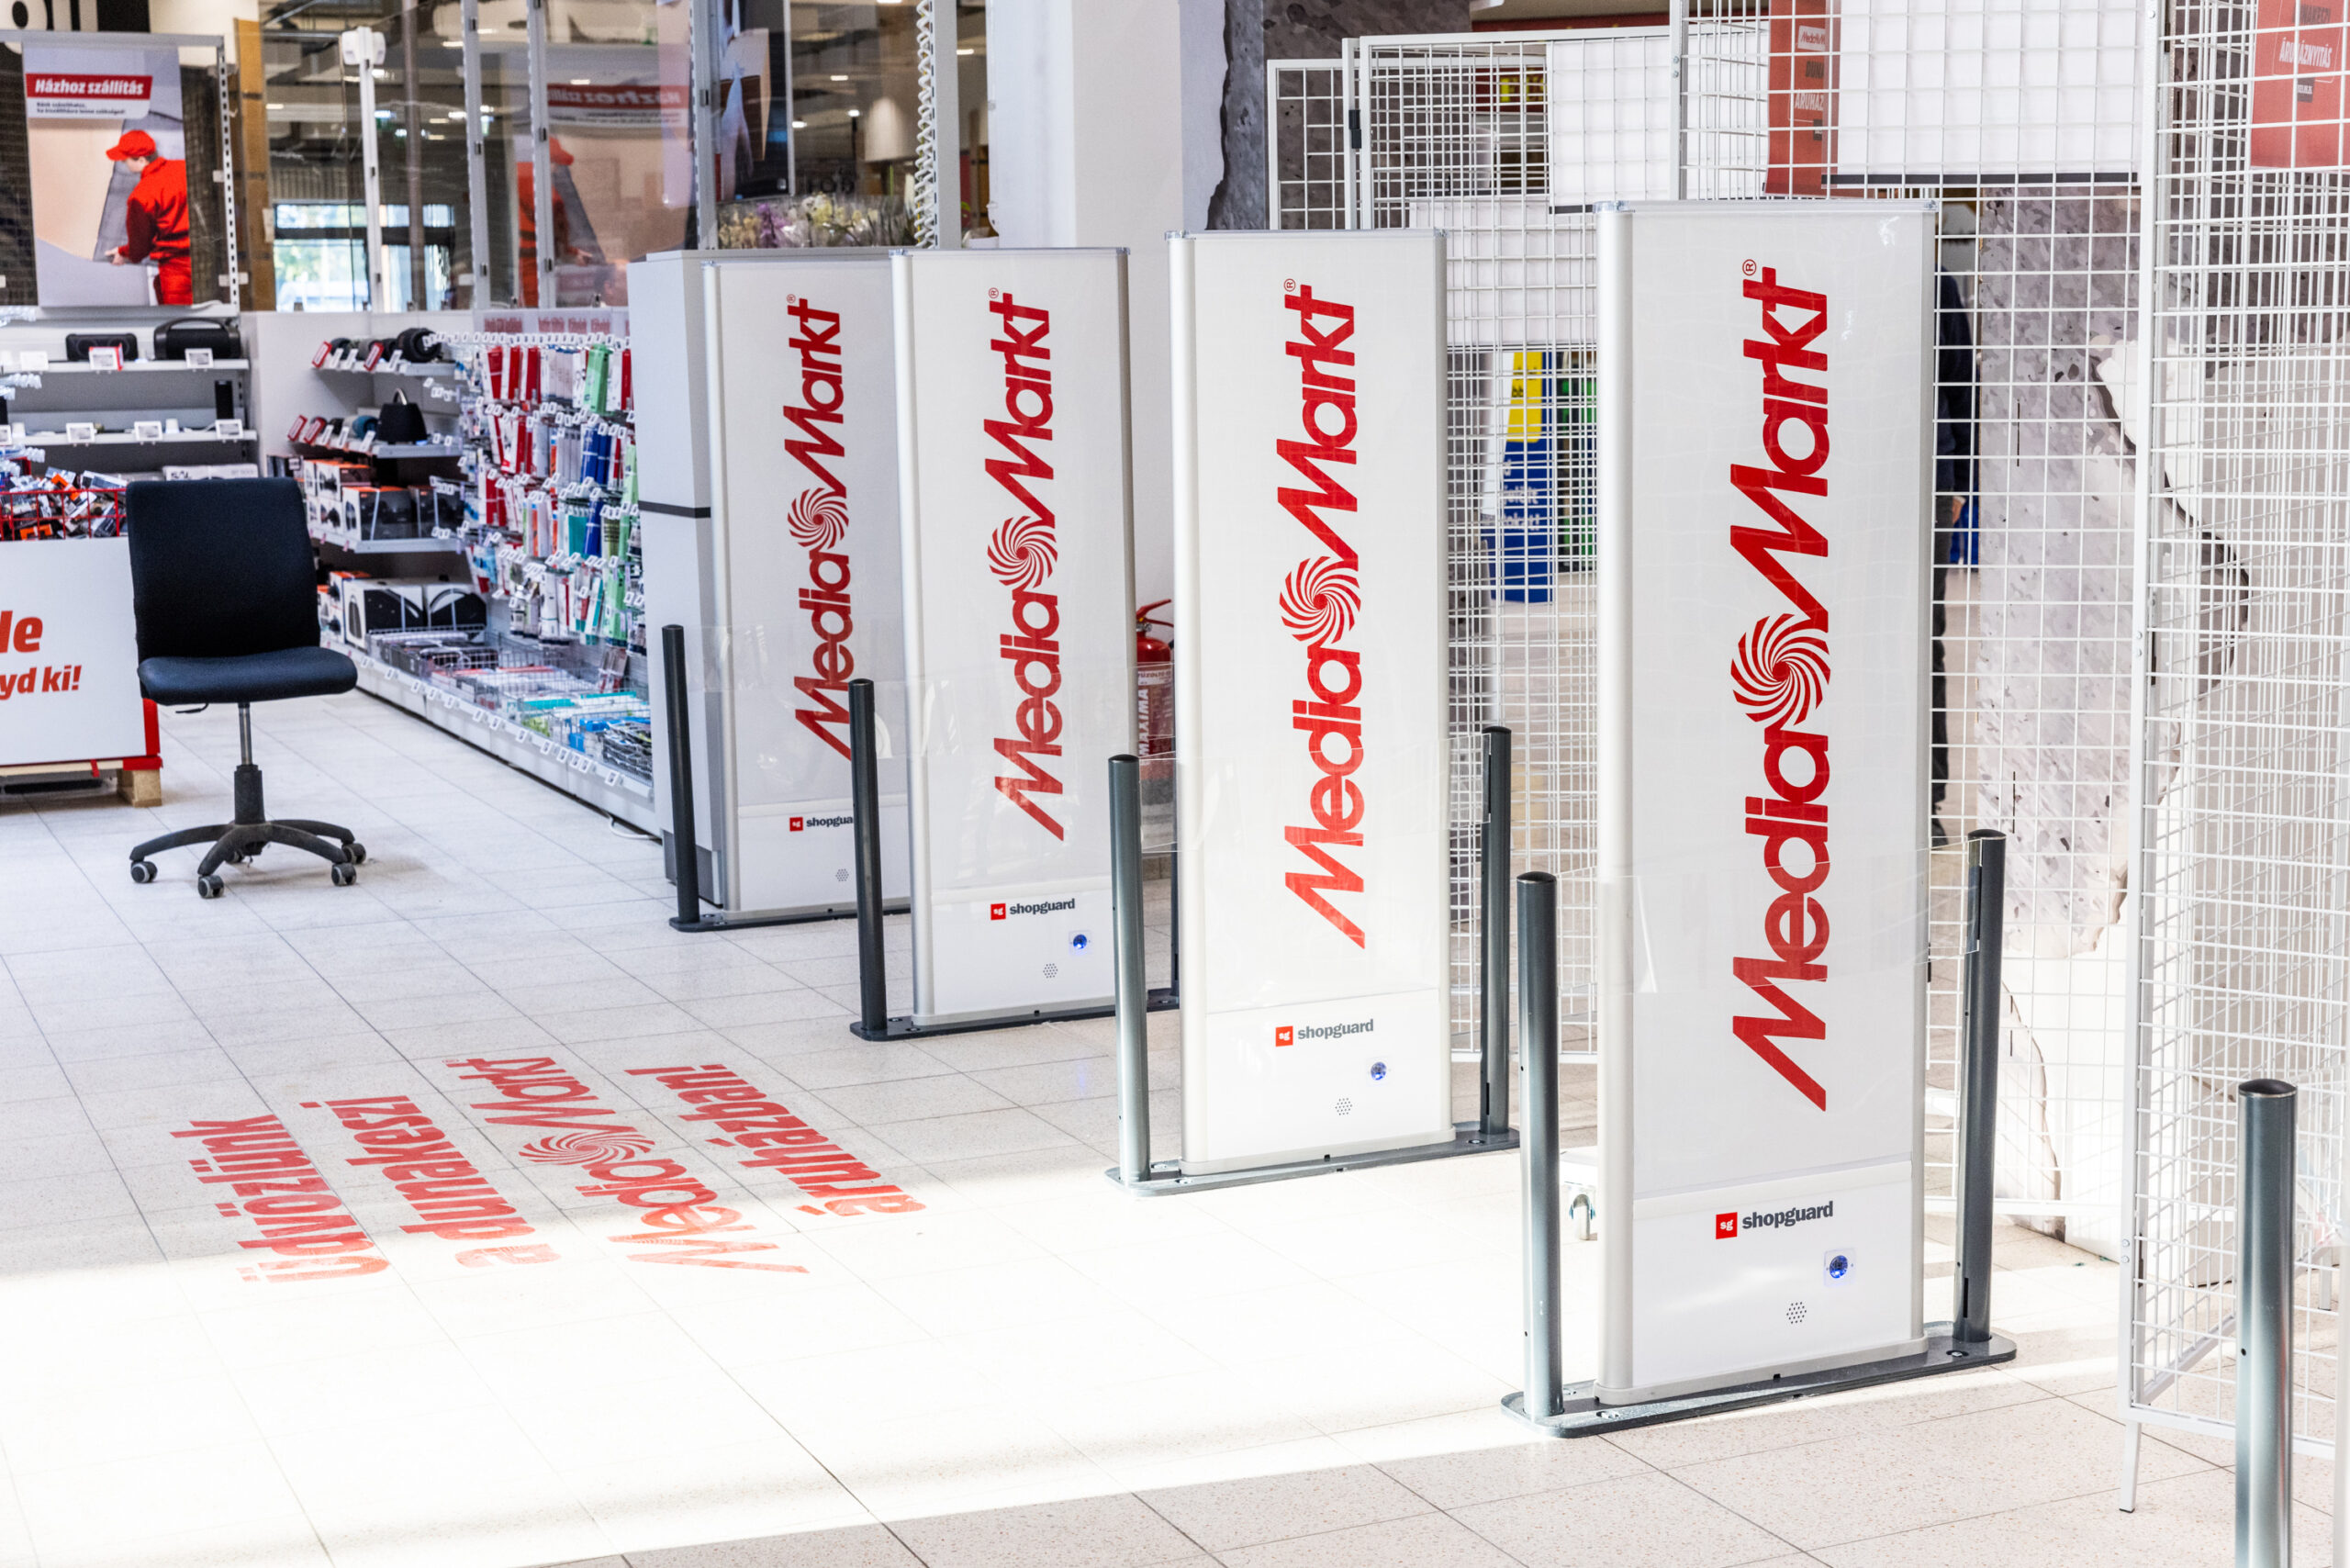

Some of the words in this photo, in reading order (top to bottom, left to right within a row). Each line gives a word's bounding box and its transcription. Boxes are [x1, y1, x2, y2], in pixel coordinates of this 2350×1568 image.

[2279, 37, 2333, 69] ÁRUÁZNYITÁS
[35, 79, 86, 94] Házhoz
[87, 79, 144, 95] szállítás
[41, 665, 82, 693] ki!
[806, 815, 853, 827] shopgua
[1009, 898, 1075, 914] shopguard
[1298, 1018, 1374, 1039] shopguard
[1742, 1201, 1833, 1229] shopguard
[454, 1242, 562, 1269] a
